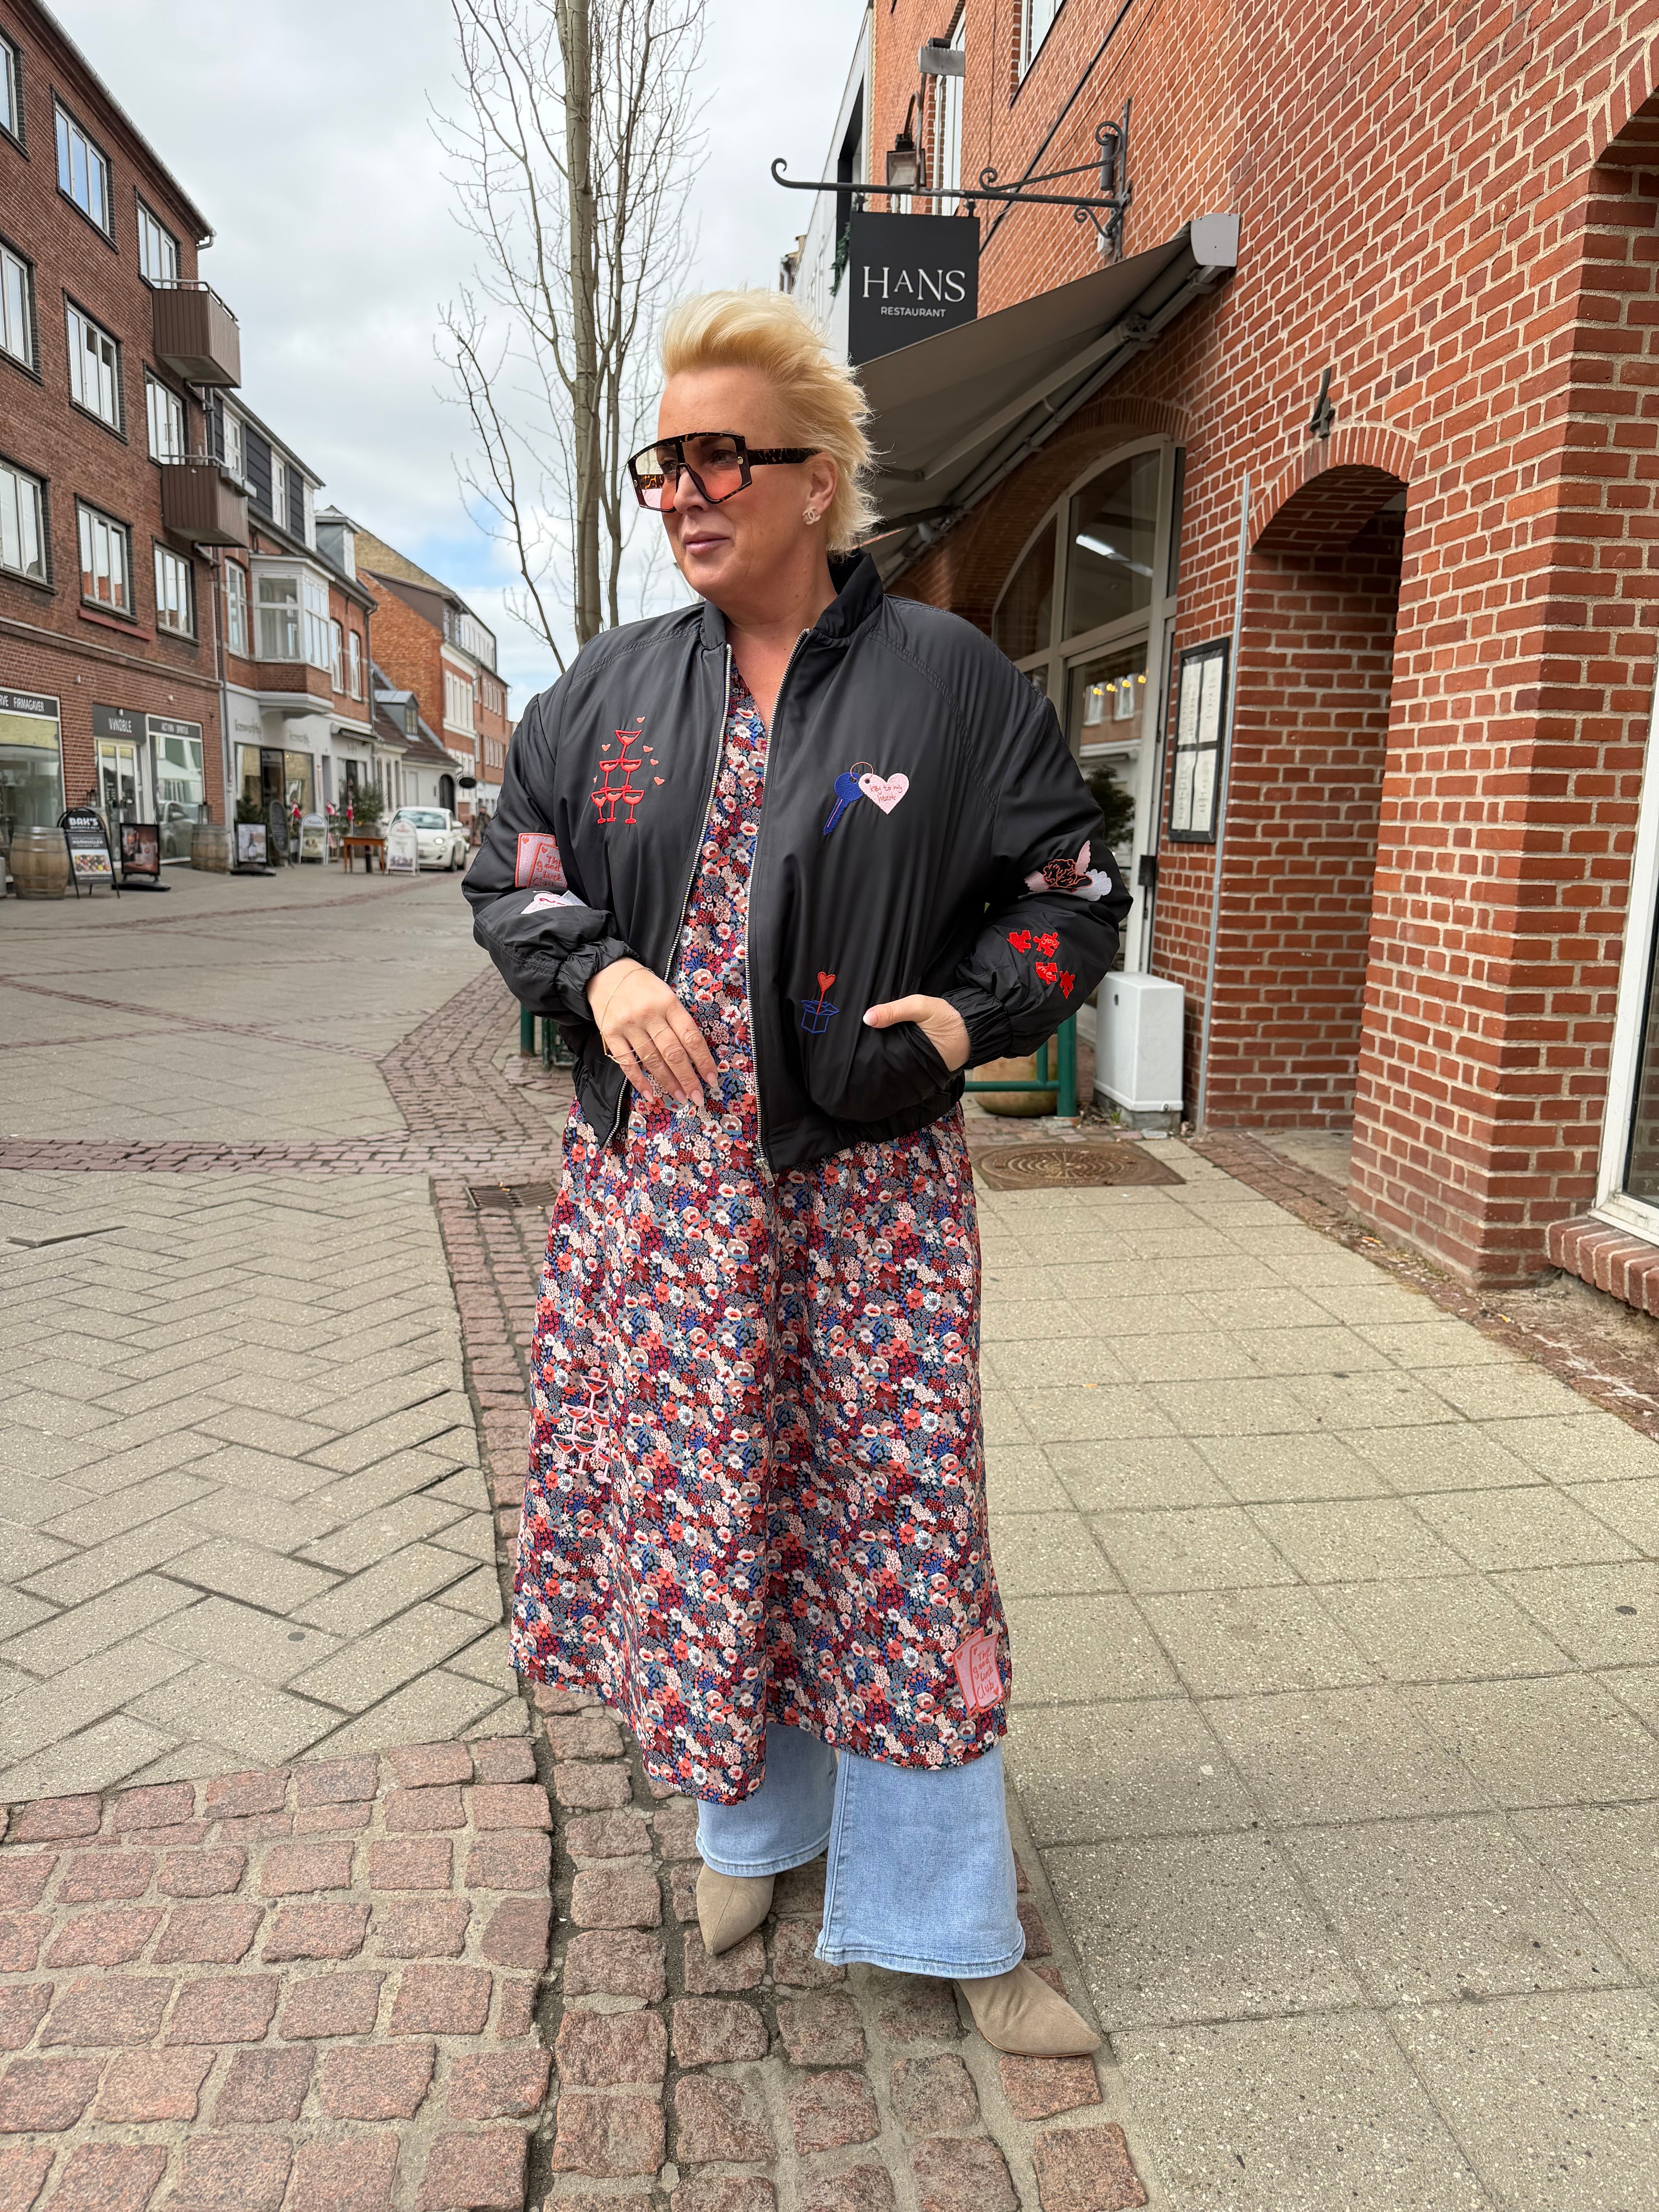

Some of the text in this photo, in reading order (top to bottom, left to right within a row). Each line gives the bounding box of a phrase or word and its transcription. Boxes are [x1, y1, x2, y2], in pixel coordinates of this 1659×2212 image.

[862, 266, 966, 302] HANS
[880, 306, 946, 318] RESTAURANT
[13, 696, 45, 712] FIRMAGAVER
[108, 717, 132, 733] VINOBLE
[870, 785, 882, 795] key
[893, 784, 902, 793] my
[1041, 936, 1057, 946] you
[1038, 965, 1052, 979] me
[977, 1680, 994, 1699] Club
